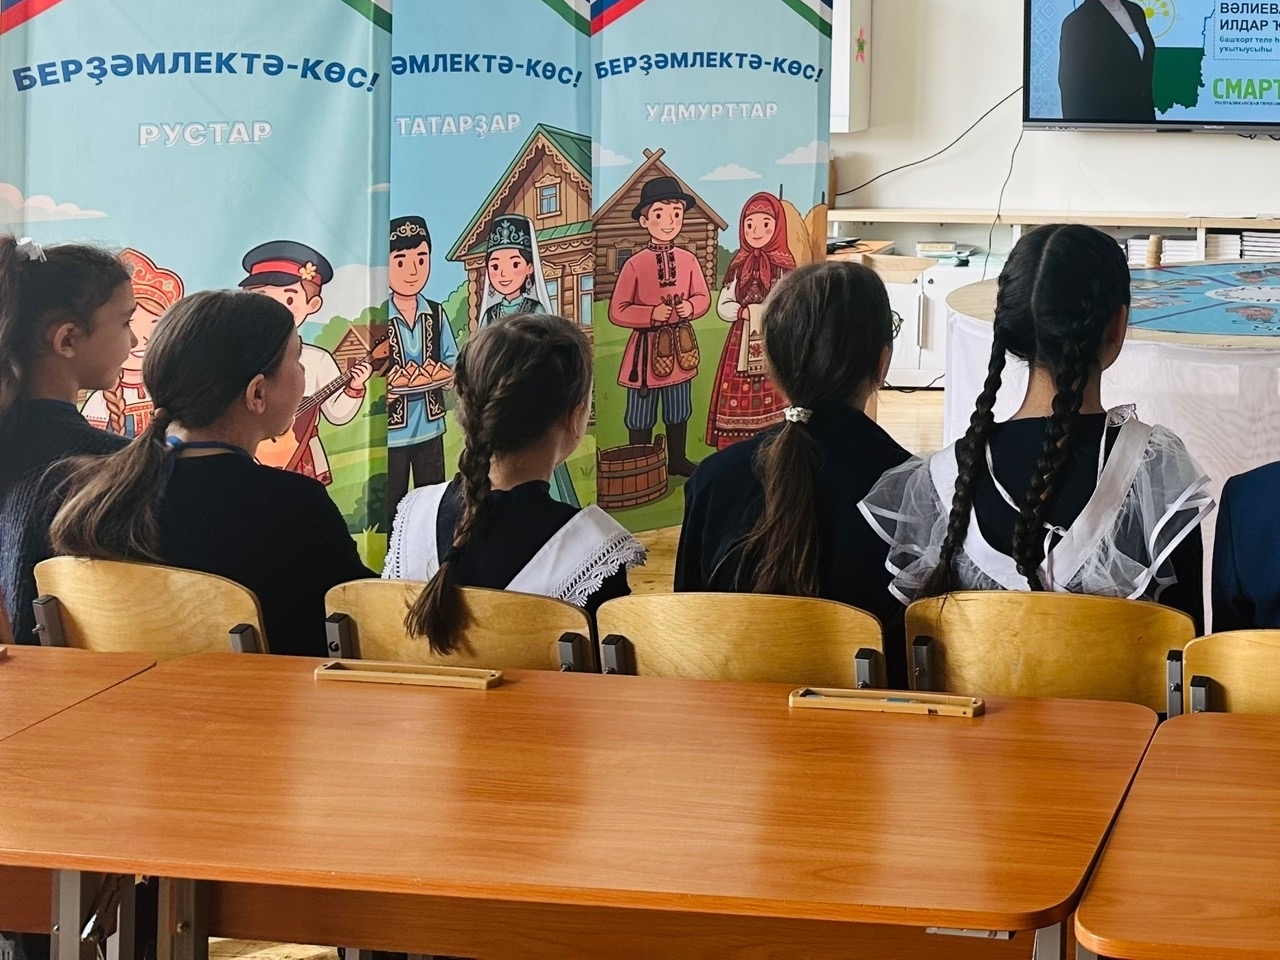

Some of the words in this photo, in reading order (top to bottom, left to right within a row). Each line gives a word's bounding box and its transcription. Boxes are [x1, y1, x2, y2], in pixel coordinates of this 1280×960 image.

[1220, 19, 1268, 32] ИЛДАР
[12, 51, 380, 92] БЕРҘӘМЛЕКТӘ-КӨС!
[391, 53, 583, 88] ӘМЛЕКТӘ-КӨС!
[594, 51, 824, 83] БЕРҘӘМЛЕКТӘ-КӨС!
[395, 112, 521, 139] ТАТАРҘАР
[644, 102, 778, 124] УДМУРТТАР
[138, 120, 273, 147] РУСТАР
